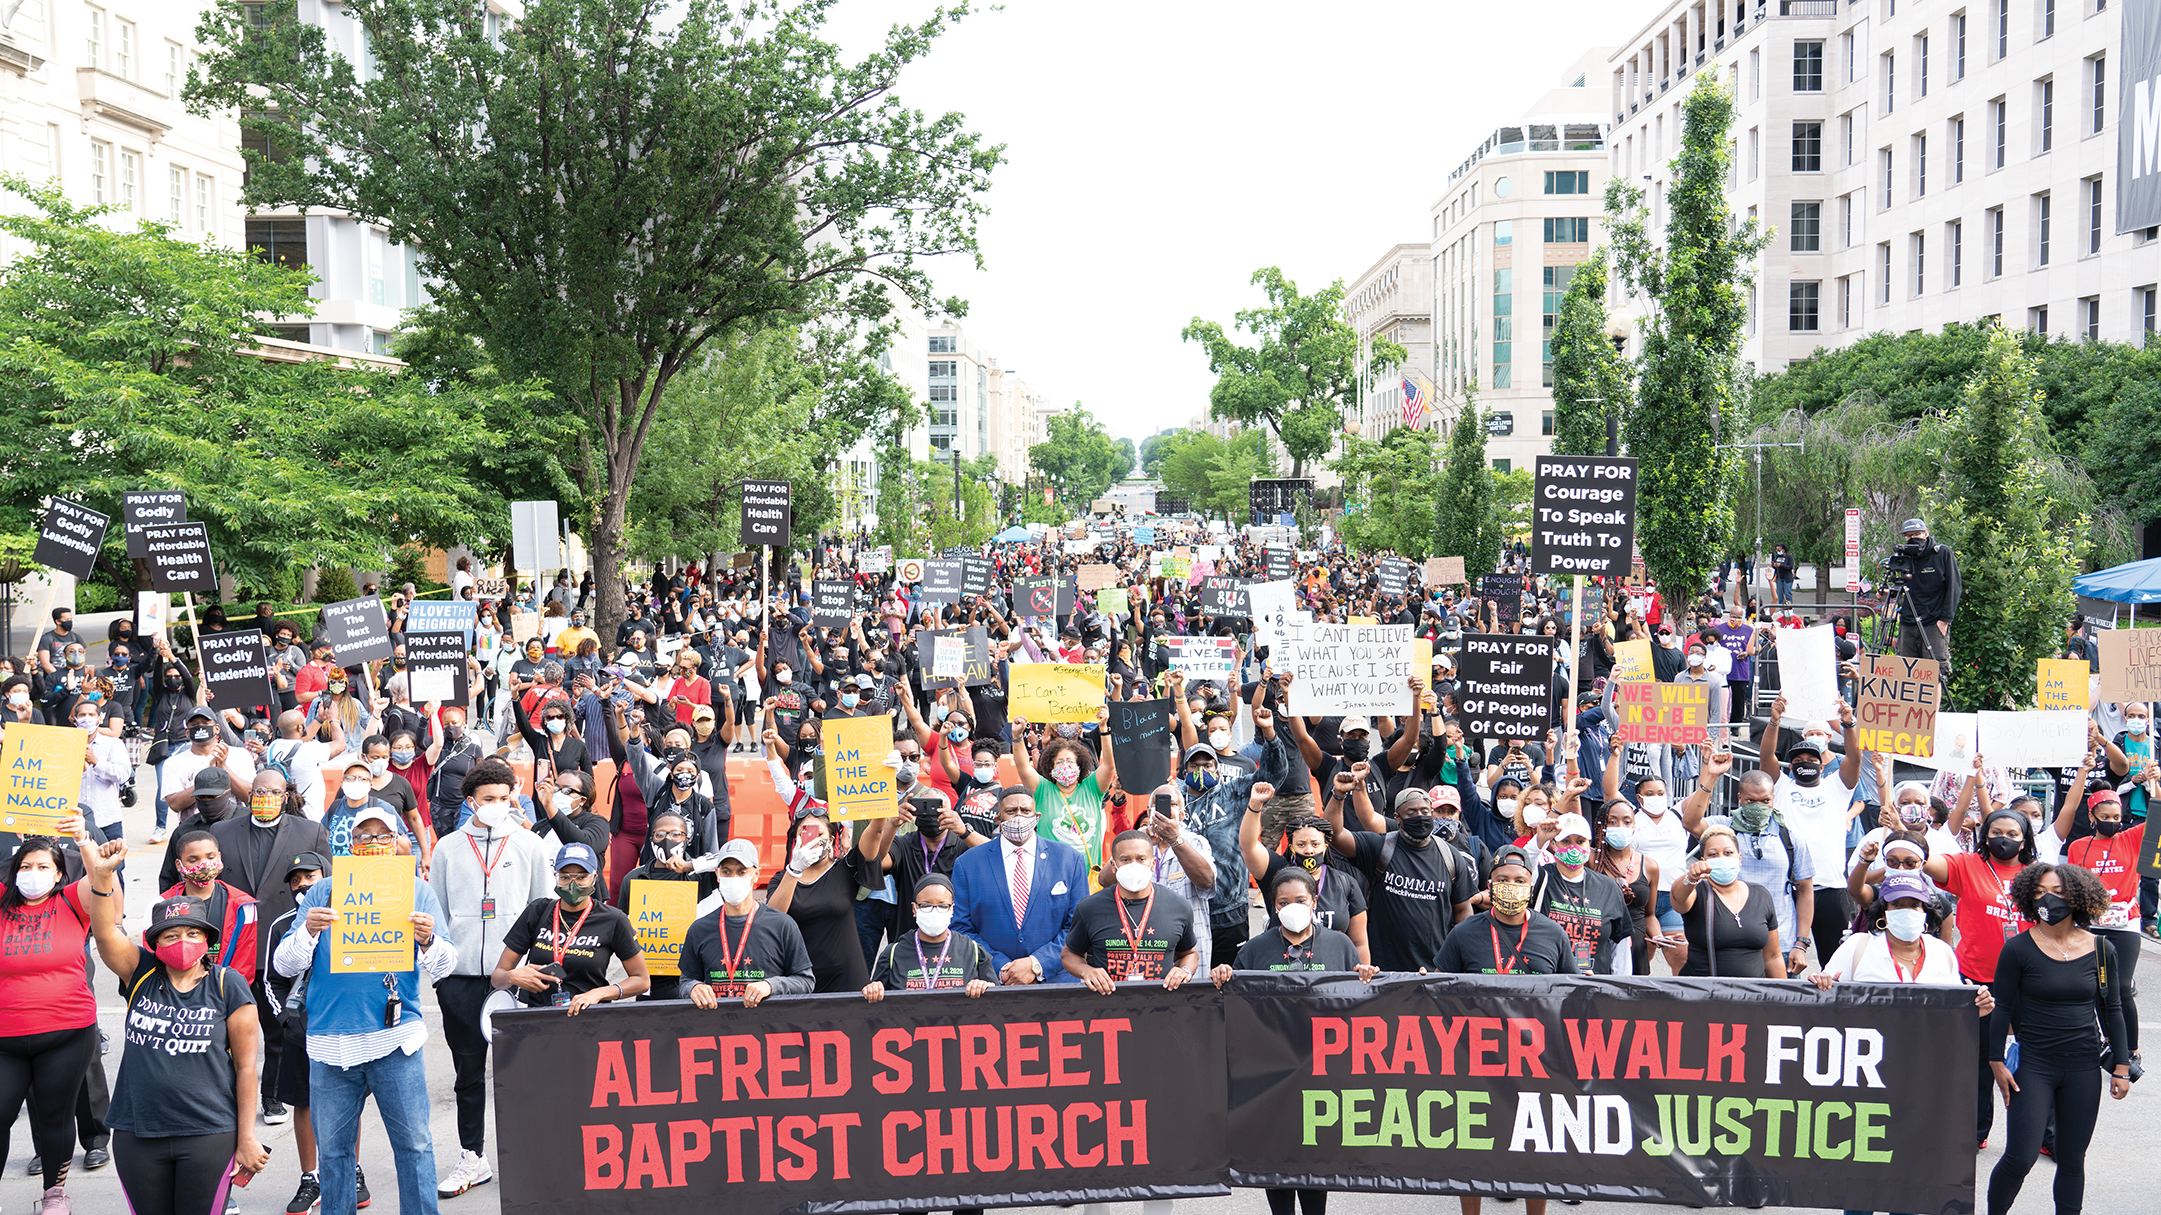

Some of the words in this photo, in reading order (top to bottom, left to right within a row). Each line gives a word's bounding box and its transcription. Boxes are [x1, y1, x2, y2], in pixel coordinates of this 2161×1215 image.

[1540, 464, 1590, 478] PRAY
[1594, 466, 1632, 480] FOR
[744, 484, 768, 493] PRAY
[770, 485, 788, 494] FOR
[1544, 484, 1624, 504] Courage
[127, 495, 157, 504] PRAY
[160, 494, 182, 504] FOR
[743, 496, 788, 506] Affordable
[54, 502, 84, 520] PRAY
[83, 514, 105, 528] FOR
[135, 506, 175, 518] Godly
[747, 508, 783, 520] Health
[1539, 508, 1564, 523] To
[1568, 509, 1627, 526] Speak
[56, 517, 94, 539] Godly
[146, 529, 177, 539] PRAY
[179, 528, 202, 537] FOR
[752, 523, 778, 534] Care
[42, 527, 96, 556] Leadership
[148, 540, 206, 552] Affordable
[1541, 531, 1592, 547] Truth
[1597, 533, 1622, 548] To
[156, 554, 203, 566] Health
[1550, 554, 1610, 571] Power
[166, 570, 200, 581] Care
[967, 566, 987, 574] Black
[1428, 574, 1465, 585] VIOLENCE
[819, 583, 849, 594] Never
[923, 586, 958, 594] Generation
[964, 583, 986, 592] Matter
[1380, 586, 1405, 595] Brutality
[1484, 588, 1520, 596] ENOUGH!
[821, 595, 846, 607] Stop
[327, 604, 355, 618] PRAY
[356, 600, 378, 611] FOR
[814, 607, 852, 618] Praying
[1204, 605, 1225, 615] Black
[344, 615, 365, 626] The
[409, 618, 473, 630] NEIGHBOR
[346, 626, 370, 638] Next
[1314, 627, 1351, 643] CAN'T
[1358, 628, 1409, 643] BELIEVE
[202, 637, 234, 650] PRAY
[235, 635, 260, 646] FOR
[334, 636, 388, 653] Generation
[408, 637, 438, 646] PRAY
[440, 636, 463, 645] FOR
[1184, 638, 1216, 646] BLACK
[408, 650, 464, 660] Affordable
[1180, 648, 1221, 658] LIVES
[1297, 646, 1340, 661] WHAT
[1349, 646, 1372, 660] YOU
[1378, 646, 1402, 659] SAY
[1467, 641, 1512, 654] PRAY
[1515, 643, 1549, 656] FOR
[213, 650, 253, 664] Godly
[206, 666, 266, 683] Leadership
[940, 664, 959, 673] BLM
[1174, 663, 1224, 672] MATTER
[1298, 664, 1360, 680] BECAUSE
[1367, 663, 1378, 678] I
[1385, 662, 1411, 677] SEE
[1490, 661, 1524, 674] Fair
[1622, 665, 1640, 673] THE
[1017, 683, 1032, 699] I
[1036, 685, 1067, 699] Can't
[1311, 682, 1347, 697] WHAT
[1351, 682, 1374, 695] YOU
[1466, 680, 1546, 696] Treatment
[1860, 676, 1935, 705] KNEE
[2045, 681, 2063, 689] AM
[1623, 684, 1653, 702] WE
[1661, 685, 1706, 704] WILL
[2045, 692, 2068, 701] THE
[1463, 700, 1485, 714] Of
[1488, 702, 1548, 718] People
[1672, 707, 1696, 725] BE
[1862, 702, 1900, 727] OFF
[1904, 706, 1937, 730] MY
[1122, 708, 1158, 730] Black
[1470, 720, 1491, 734] Of
[1494, 722, 1540, 736] Color
[1618, 724, 1709, 744] SILENCED
[1859, 728, 1932, 758] NECK
[835, 749, 860, 762] AM
[12, 757, 42, 771] AM
[836, 766, 868, 779] THE
[11, 775, 48, 790] THE
[837, 781, 889, 796] NAACP.
[1437, 788, 1456, 799] DC
[7, 793, 68, 810] NAACP.
[960, 805, 997, 819] CHURCH
[1384, 871, 1446, 893] MOMMA!!
[344, 893, 373, 906] AM
[343, 912, 381, 925] THE
[638, 911, 662, 923] AM
[18, 921, 42, 934] FOR
[638, 928, 669, 938] THE
[5, 931, 53, 945] BLACK
[343, 931, 405, 945] NAACP.
[1154, 940, 1168, 948] 2020
[5, 943, 53, 957] LIVES
[750, 970, 764, 978] 2020
[137, 995, 177, 1018] DON'T
[176, 1007, 217, 1022] QUIT
[130, 1010, 172, 1034] WON'T
[171, 1022, 214, 1038] QUIT
[126, 1027, 164, 1050] CAN'T
[165, 1039, 212, 1056] QUIT
[1311, 1016, 1550, 1079] PRAYER
[1563, 1019, 1748, 1083] WALK
[1765, 1024, 1886, 1089] FOR
[590, 1030, 852, 1108] ALFRED
[872, 1018, 1132, 1095] STREET
[1301, 1088, 1494, 1151] PEACE
[1508, 1091, 1633, 1156] AND
[1642, 1094, 1894, 1164] JUSTICE
[580, 1112, 861, 1190] BAPTIST
[881, 1099, 1150, 1177] CHURCH
